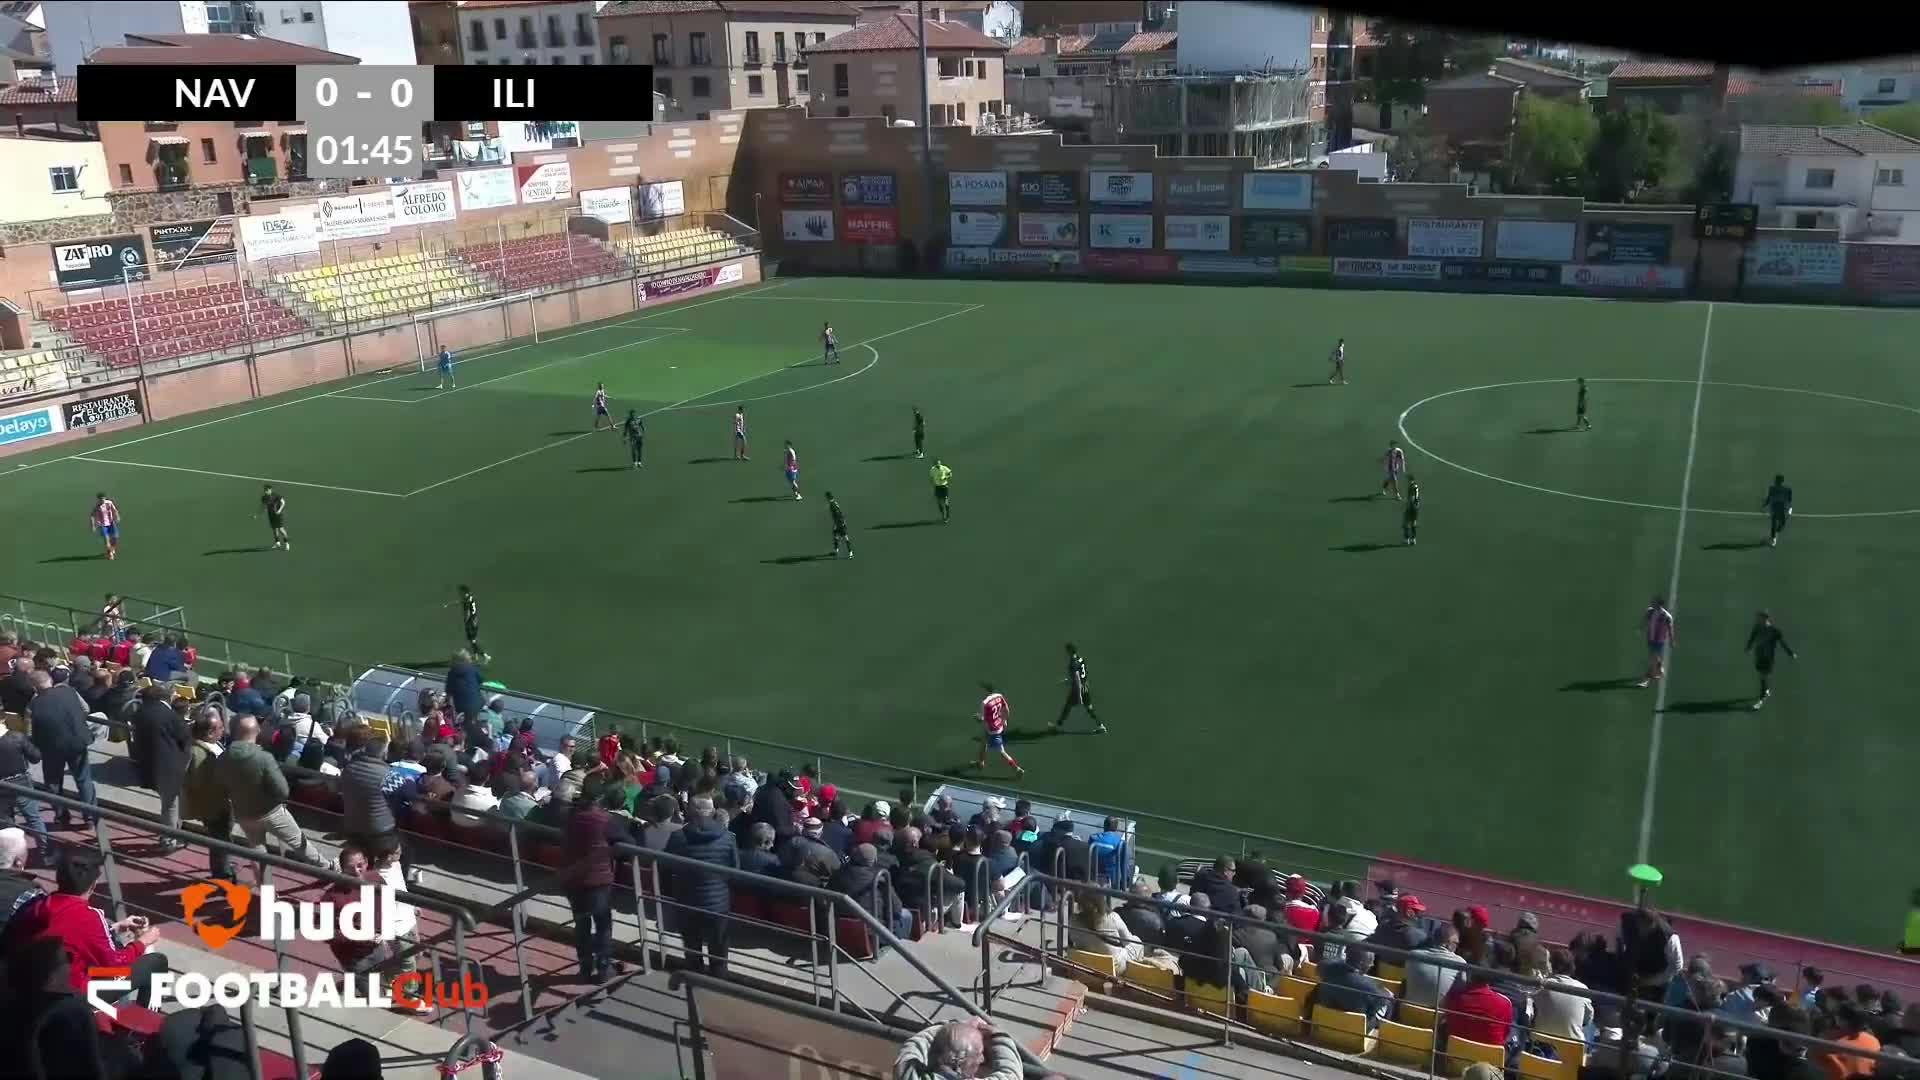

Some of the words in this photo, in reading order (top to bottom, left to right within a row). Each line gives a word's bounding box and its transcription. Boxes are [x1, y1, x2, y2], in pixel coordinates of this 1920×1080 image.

[402, 192, 446, 206] ALFREDO
[403, 202, 447, 216] COLOMO
[64, 245, 113, 261] ZAFIRO
[72, 394, 129, 412] RESTAURANTE
[86, 408, 98, 417] EL
[97, 399, 136, 414] CAZADOR
[105, 411, 117, 420] 811
